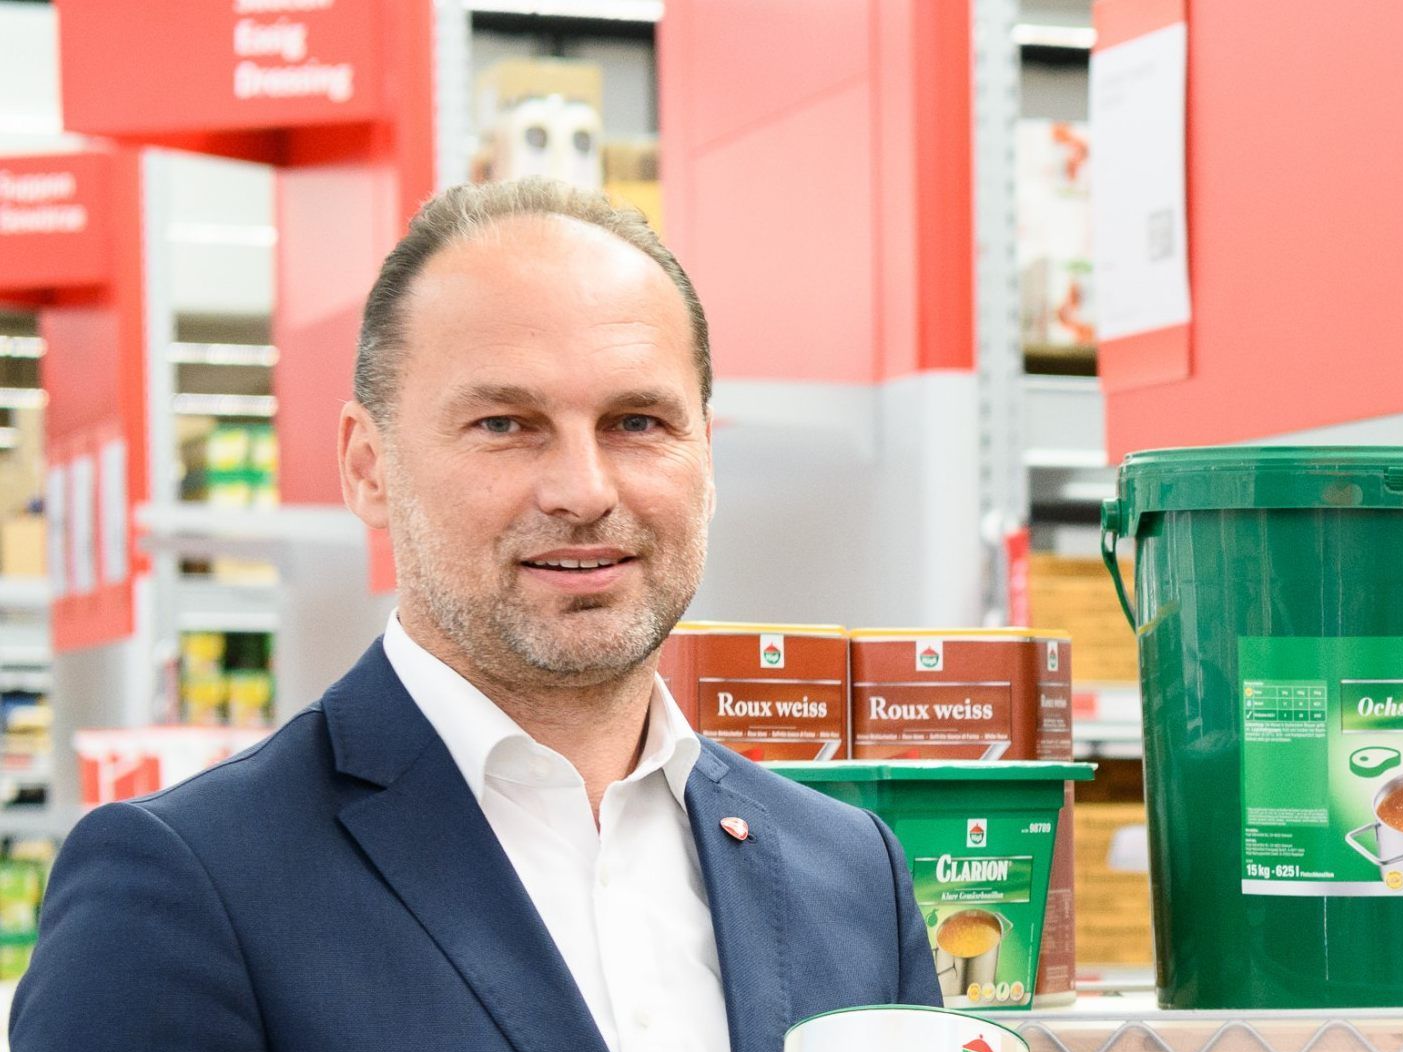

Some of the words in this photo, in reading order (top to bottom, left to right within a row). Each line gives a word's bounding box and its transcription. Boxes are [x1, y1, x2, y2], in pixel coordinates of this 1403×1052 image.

[717, 691, 772, 718] Roux
[775, 695, 828, 718] weiss
[869, 696, 930, 720] Roux
[933, 698, 993, 720] weiss
